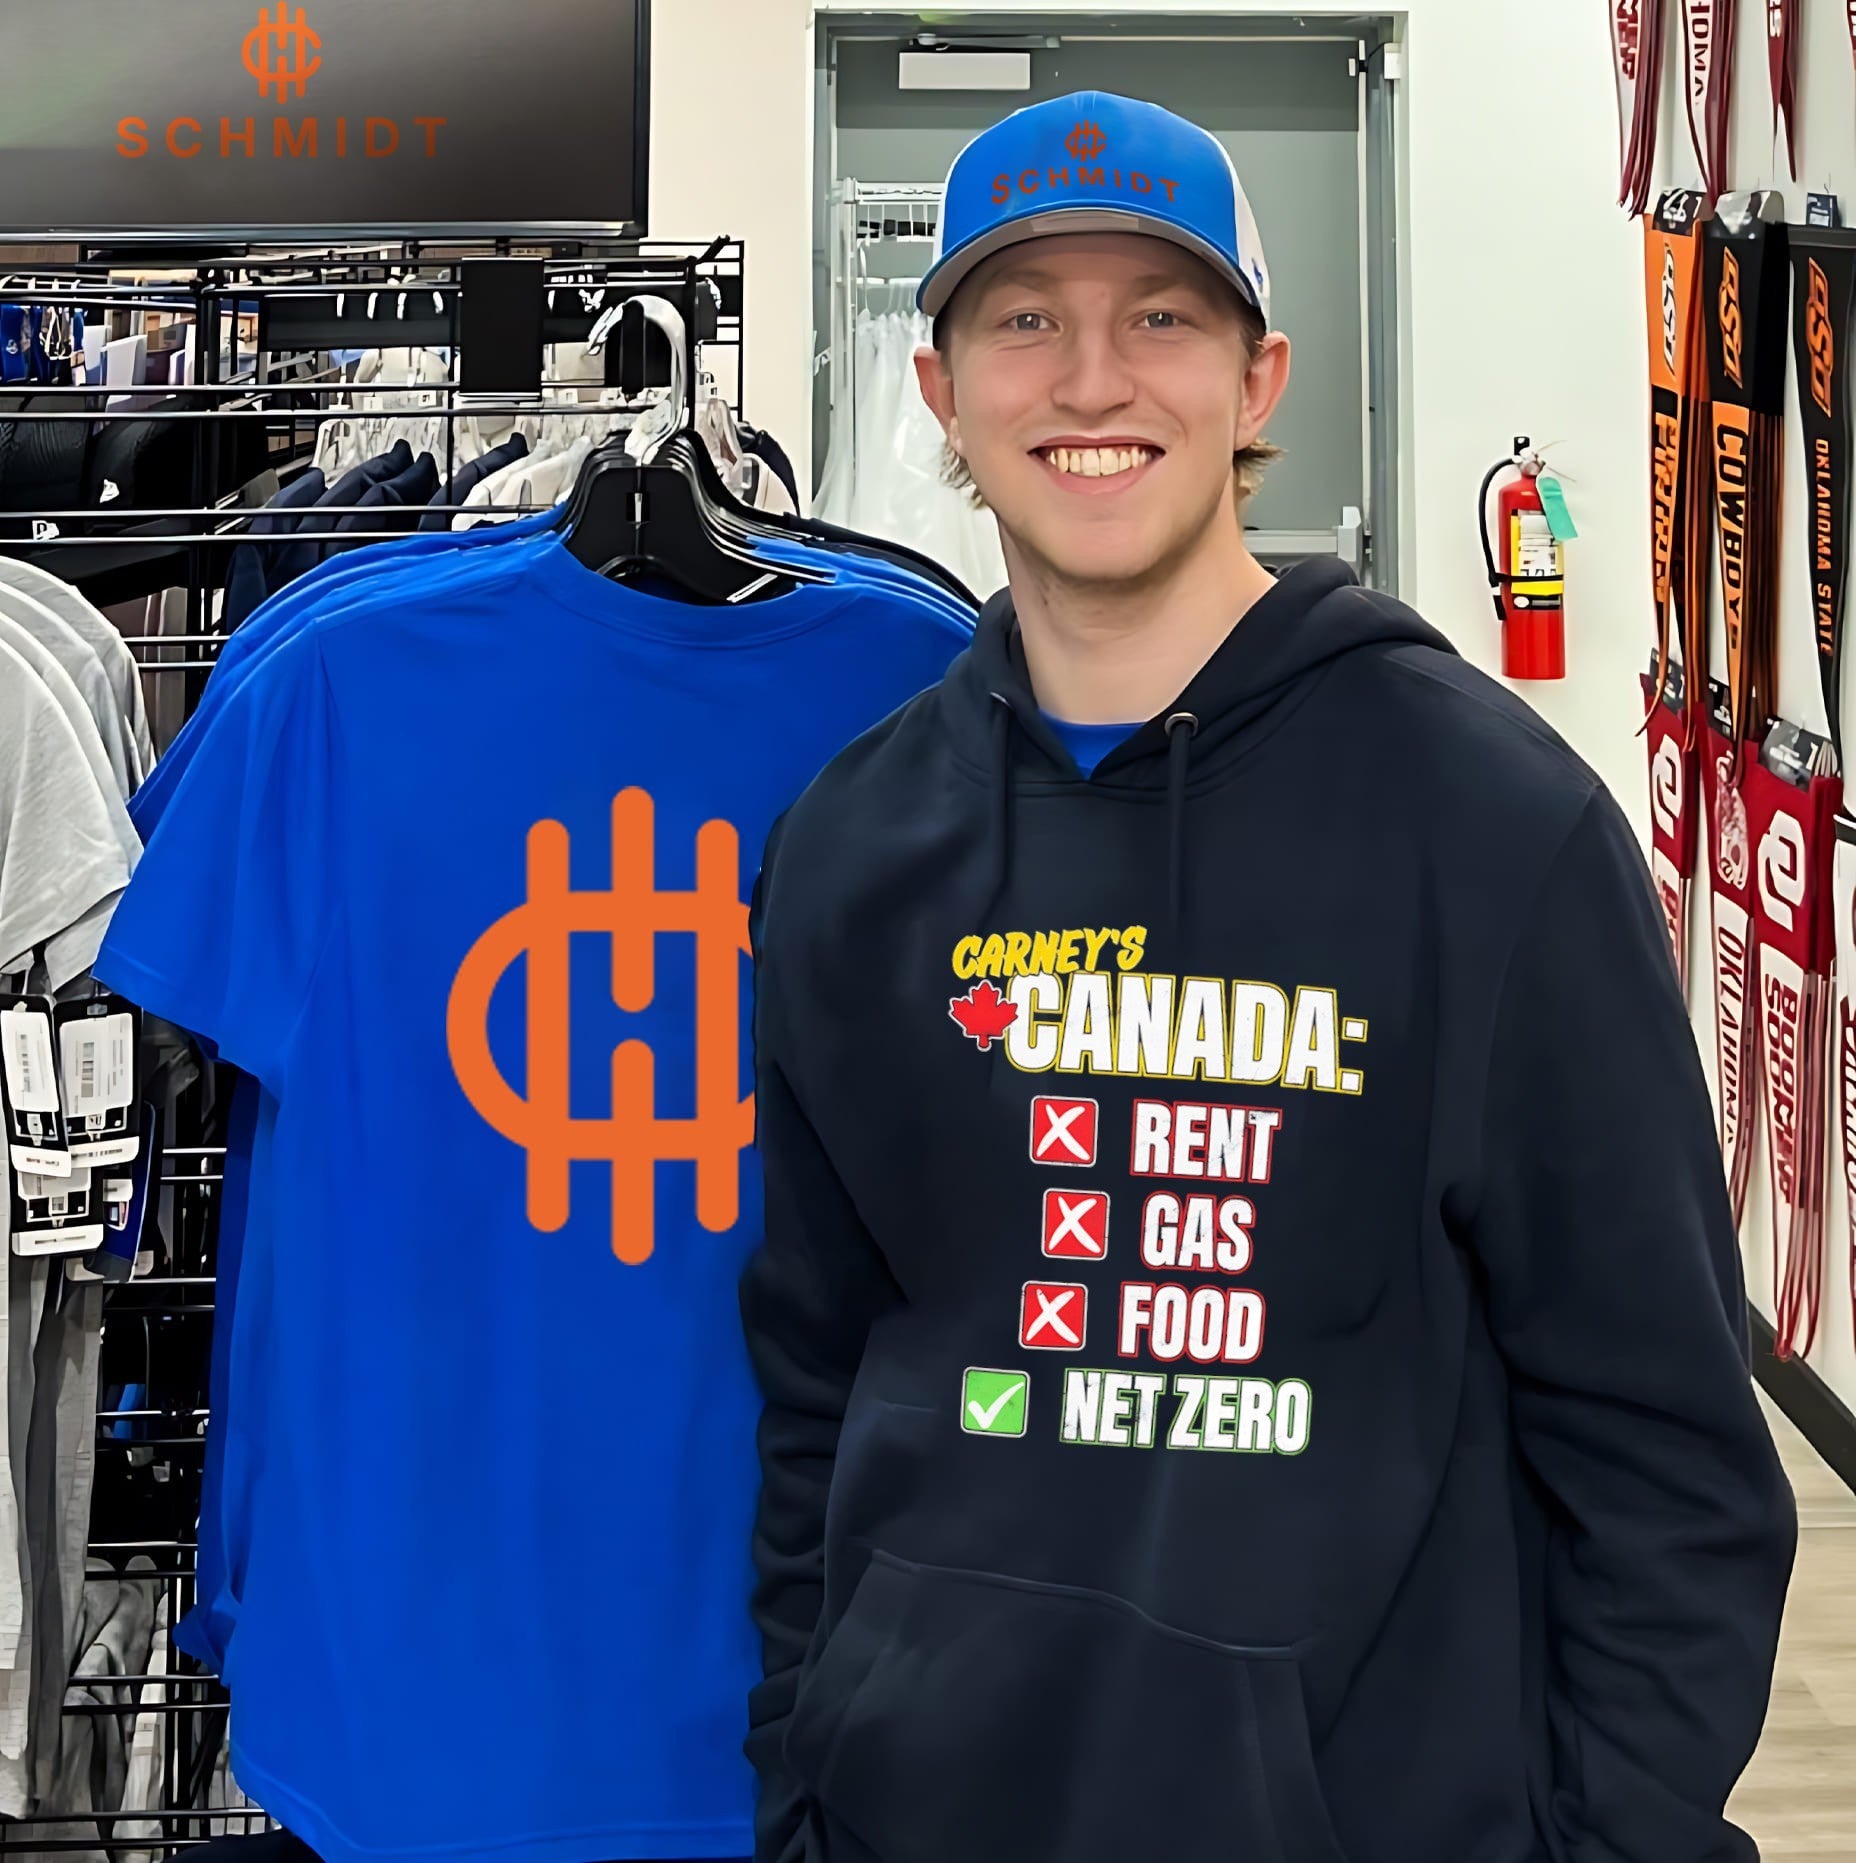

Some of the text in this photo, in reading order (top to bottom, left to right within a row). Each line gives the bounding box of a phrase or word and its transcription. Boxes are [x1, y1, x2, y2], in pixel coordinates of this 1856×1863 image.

[115, 116, 447, 159] SCHMIDT
[991, 166, 1180, 204] SCHMIDT
[952, 925, 1148, 979] CARNEY'S
[1005, 970, 1369, 1096] CANADA:
[1130, 1098, 1283, 1184] RENT
[1140, 1190, 1257, 1275] GAS
[1117, 1281, 1267, 1364] FOOD
[1059, 1367, 1313, 1456] NET ZERO
